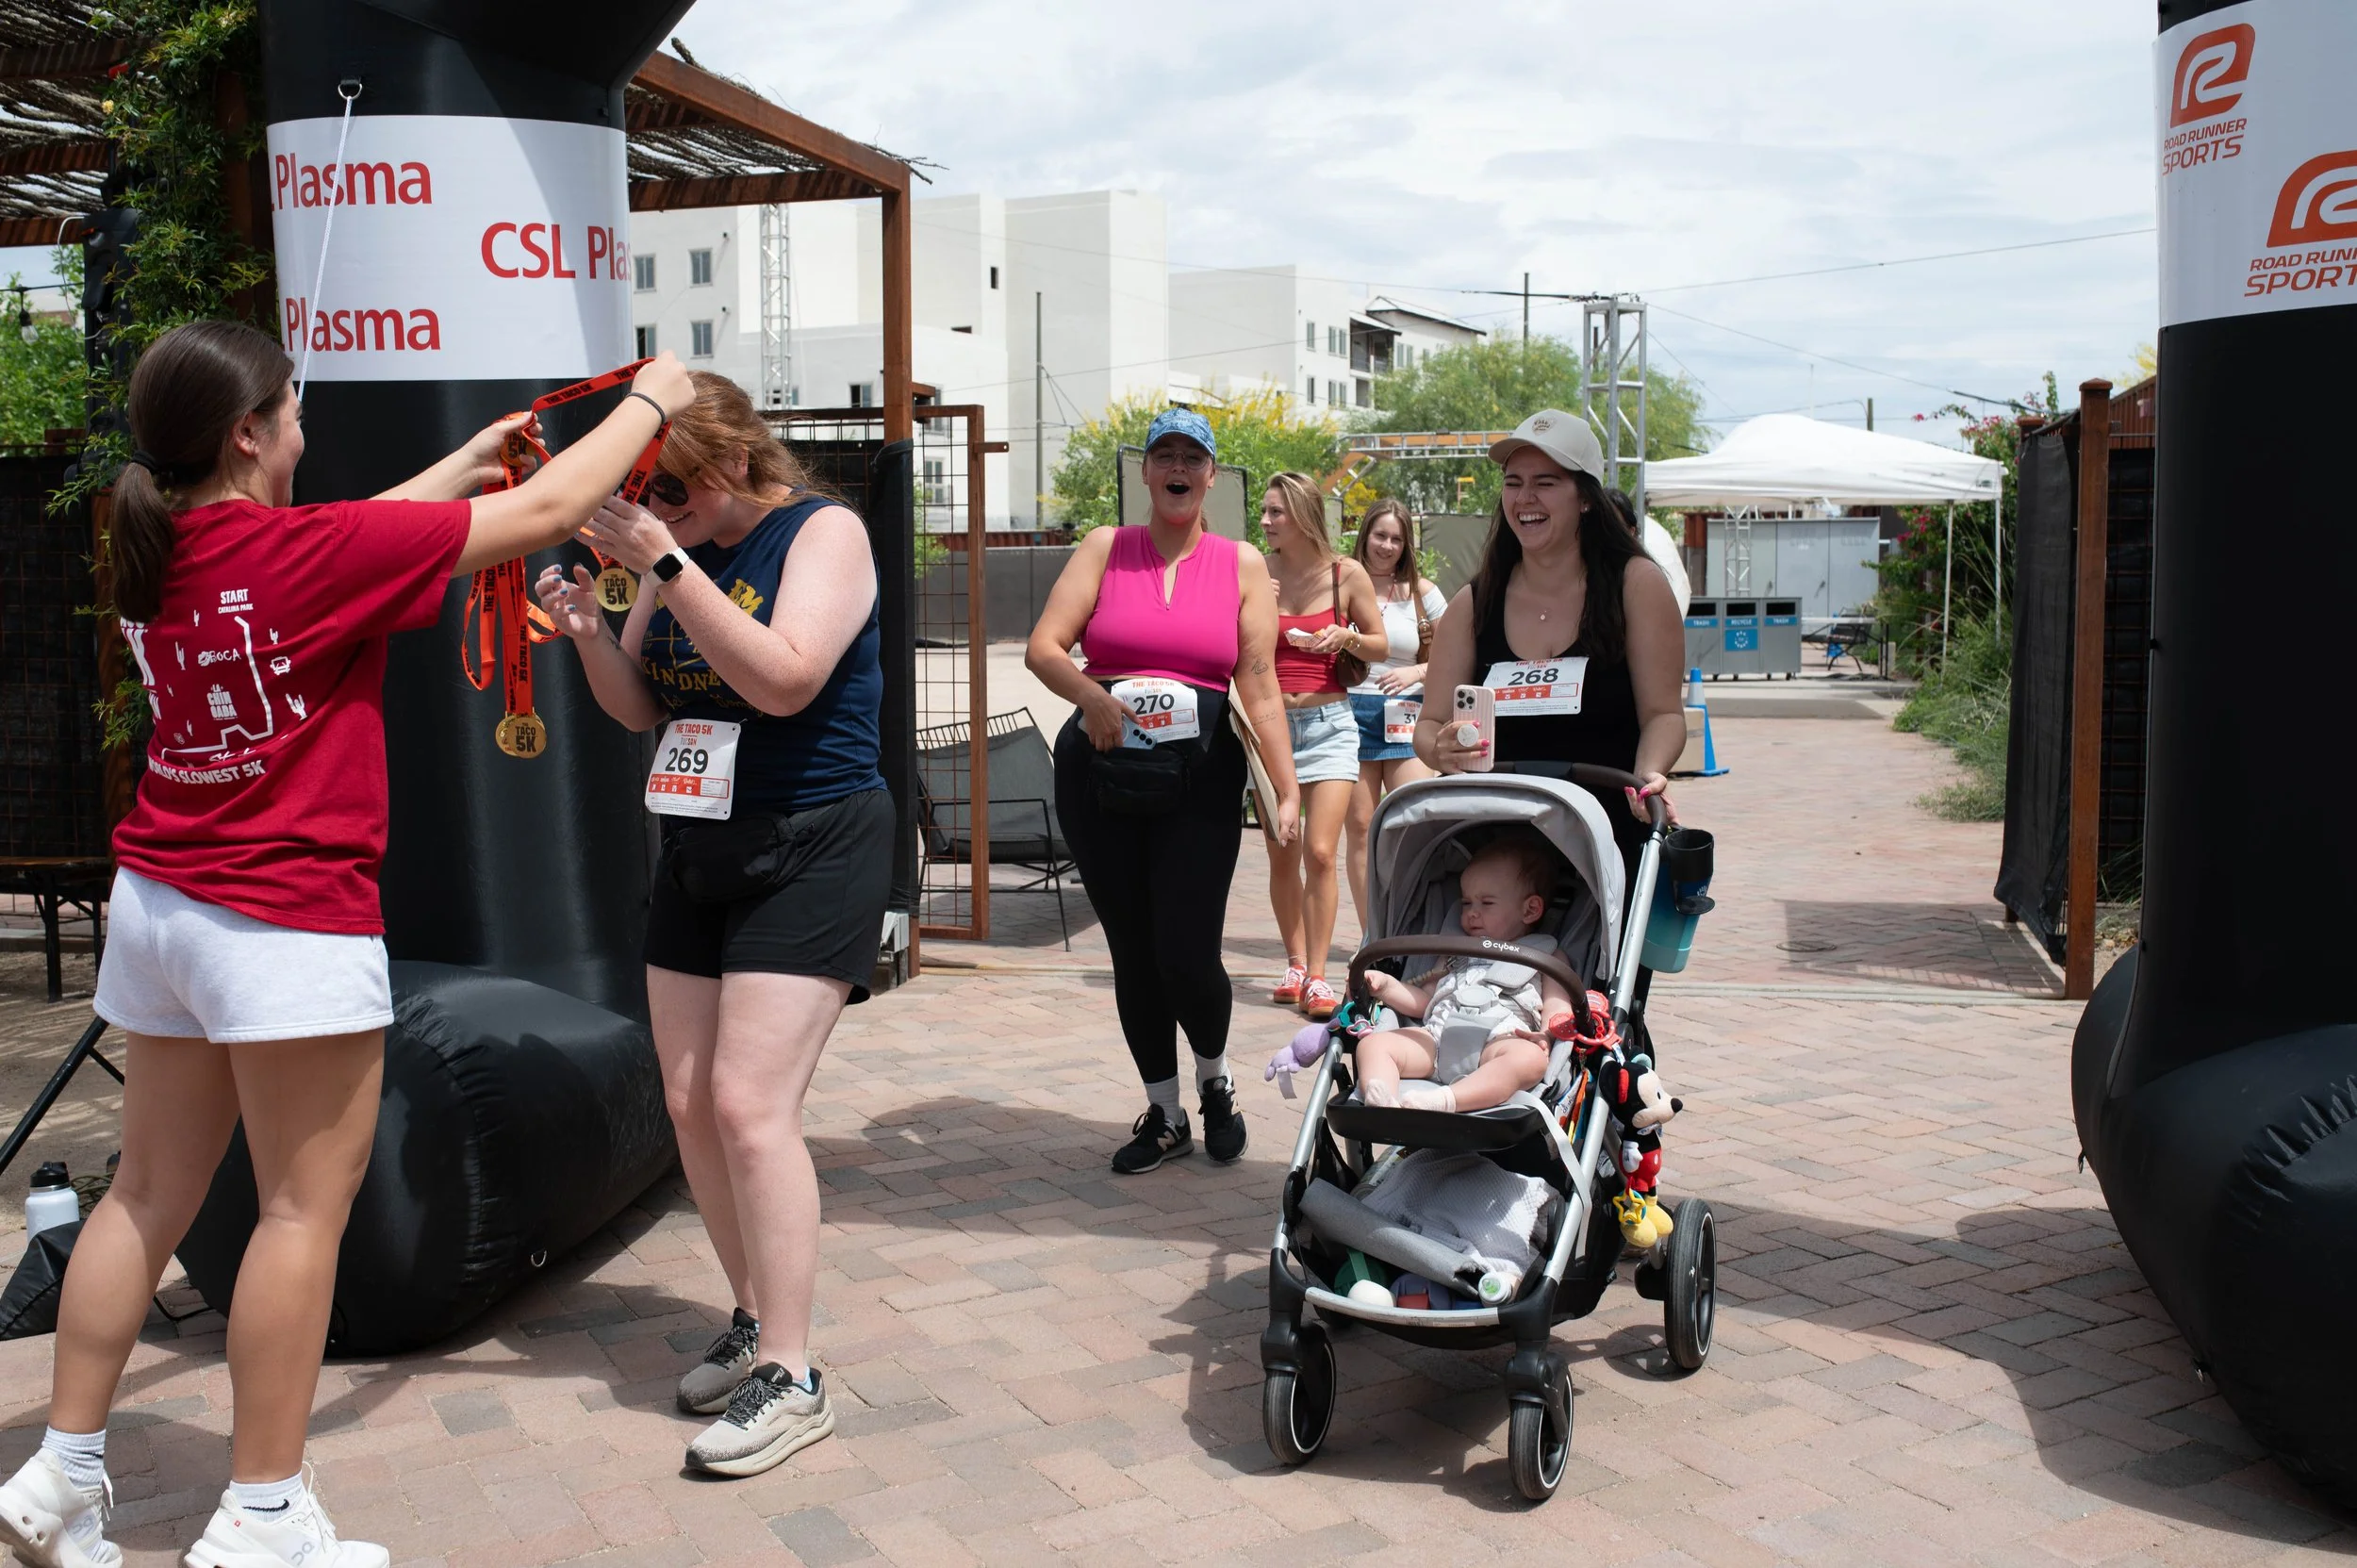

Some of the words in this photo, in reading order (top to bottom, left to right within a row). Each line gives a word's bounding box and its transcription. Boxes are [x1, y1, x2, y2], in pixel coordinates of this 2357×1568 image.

[2164, 133, 2186, 151] ROAD
[2188, 118, 2248, 143] RUNNER
[2162, 134, 2244, 176] SPORTS
[275, 153, 433, 210] Plasma
[481, 222, 576, 279] CSL
[2250, 254, 2302, 272] ROAD
[285, 296, 441, 353] Plasma
[484, 569, 496, 593] TACO
[603, 577, 627, 588] TACO
[220, 588, 249, 604] START
[484, 595, 494, 613] THE
[605, 586, 630, 605] 5K
[1508, 668, 1559, 686] 268
[1133, 693, 1175, 715] 270
[515, 726, 536, 736] TACO
[675, 723, 684, 734] THE
[684, 724, 701, 734] TACO
[701, 725, 713, 735] 5K
[516, 735, 536, 752] 5K
[665, 747, 709, 774] 269
[178, 766, 240, 784] SLOWEST
[241, 759, 266, 778] 5K
[1492, 942, 1521, 952] cybex
